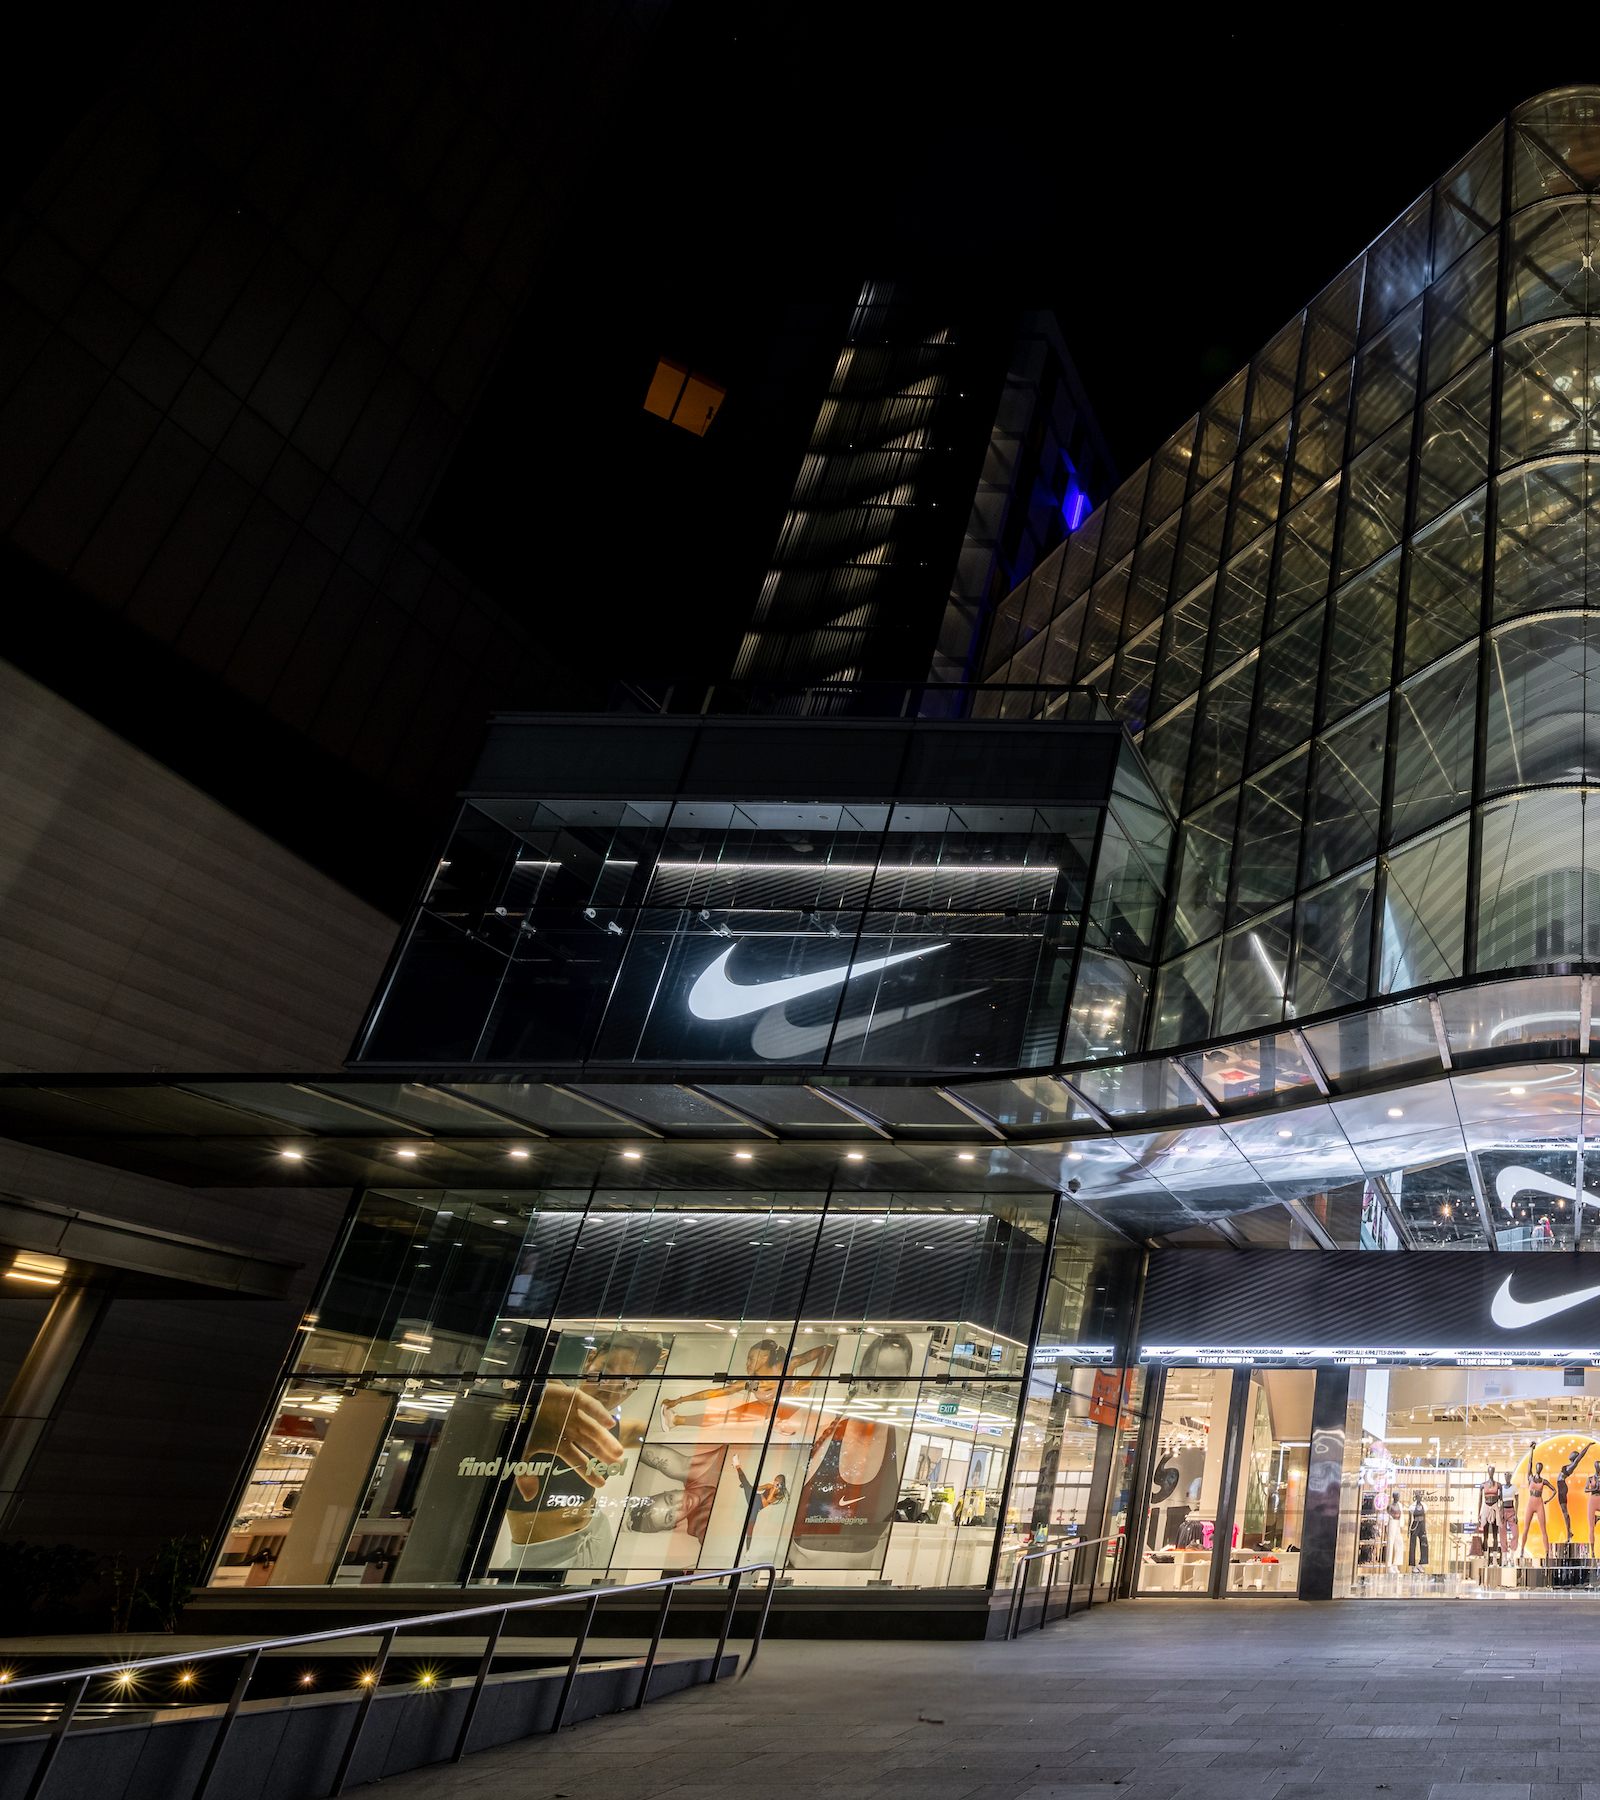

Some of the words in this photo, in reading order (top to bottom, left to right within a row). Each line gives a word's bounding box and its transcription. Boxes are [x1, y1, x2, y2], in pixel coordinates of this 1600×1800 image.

[939, 1404, 954, 1414] EXIT
[457, 1457, 502, 1476] find
[500, 1461, 552, 1481] your
[585, 1457, 629, 1476] feel
